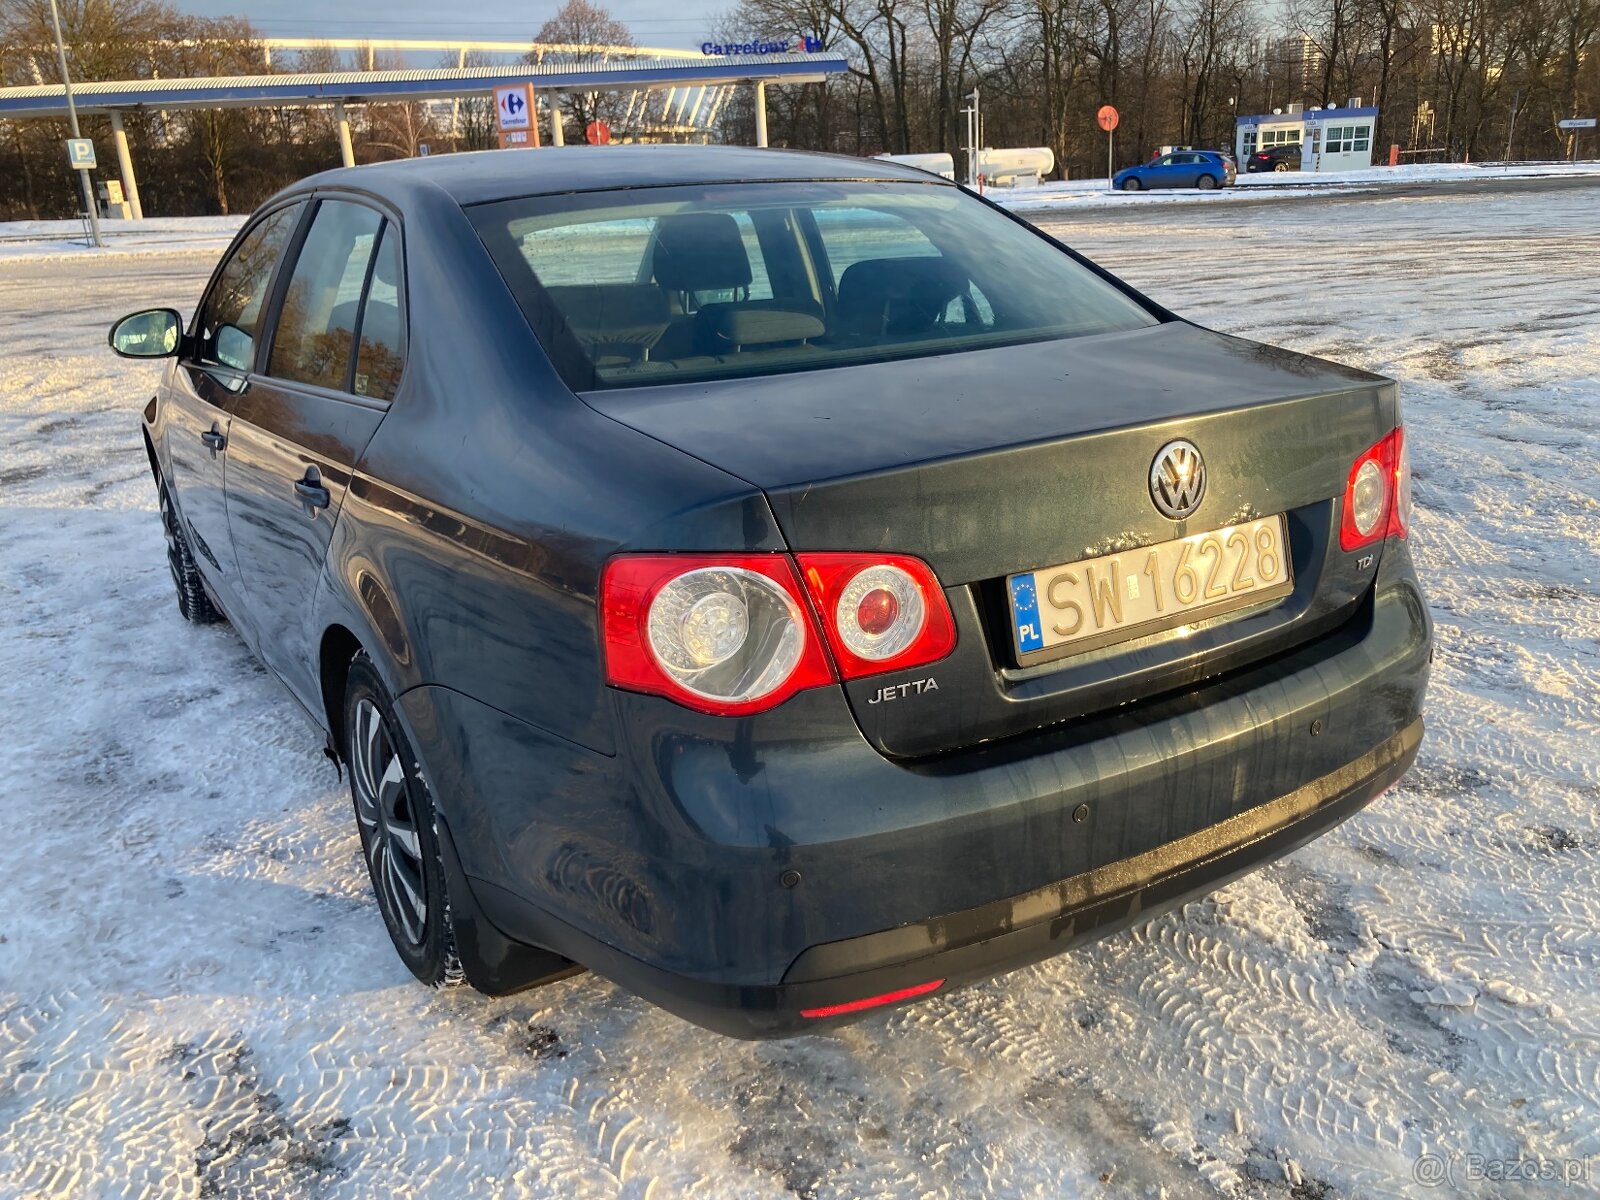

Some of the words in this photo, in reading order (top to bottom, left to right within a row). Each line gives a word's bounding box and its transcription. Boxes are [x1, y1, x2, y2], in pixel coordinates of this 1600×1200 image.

[701, 39, 789, 55] Carrefour
[74, 142, 90, 160] P
[1046, 559, 1124, 637] SW
[1143, 524, 1280, 613] 16228
[1019, 624, 1040, 643] PL
[867, 677, 939, 705] JETTA
